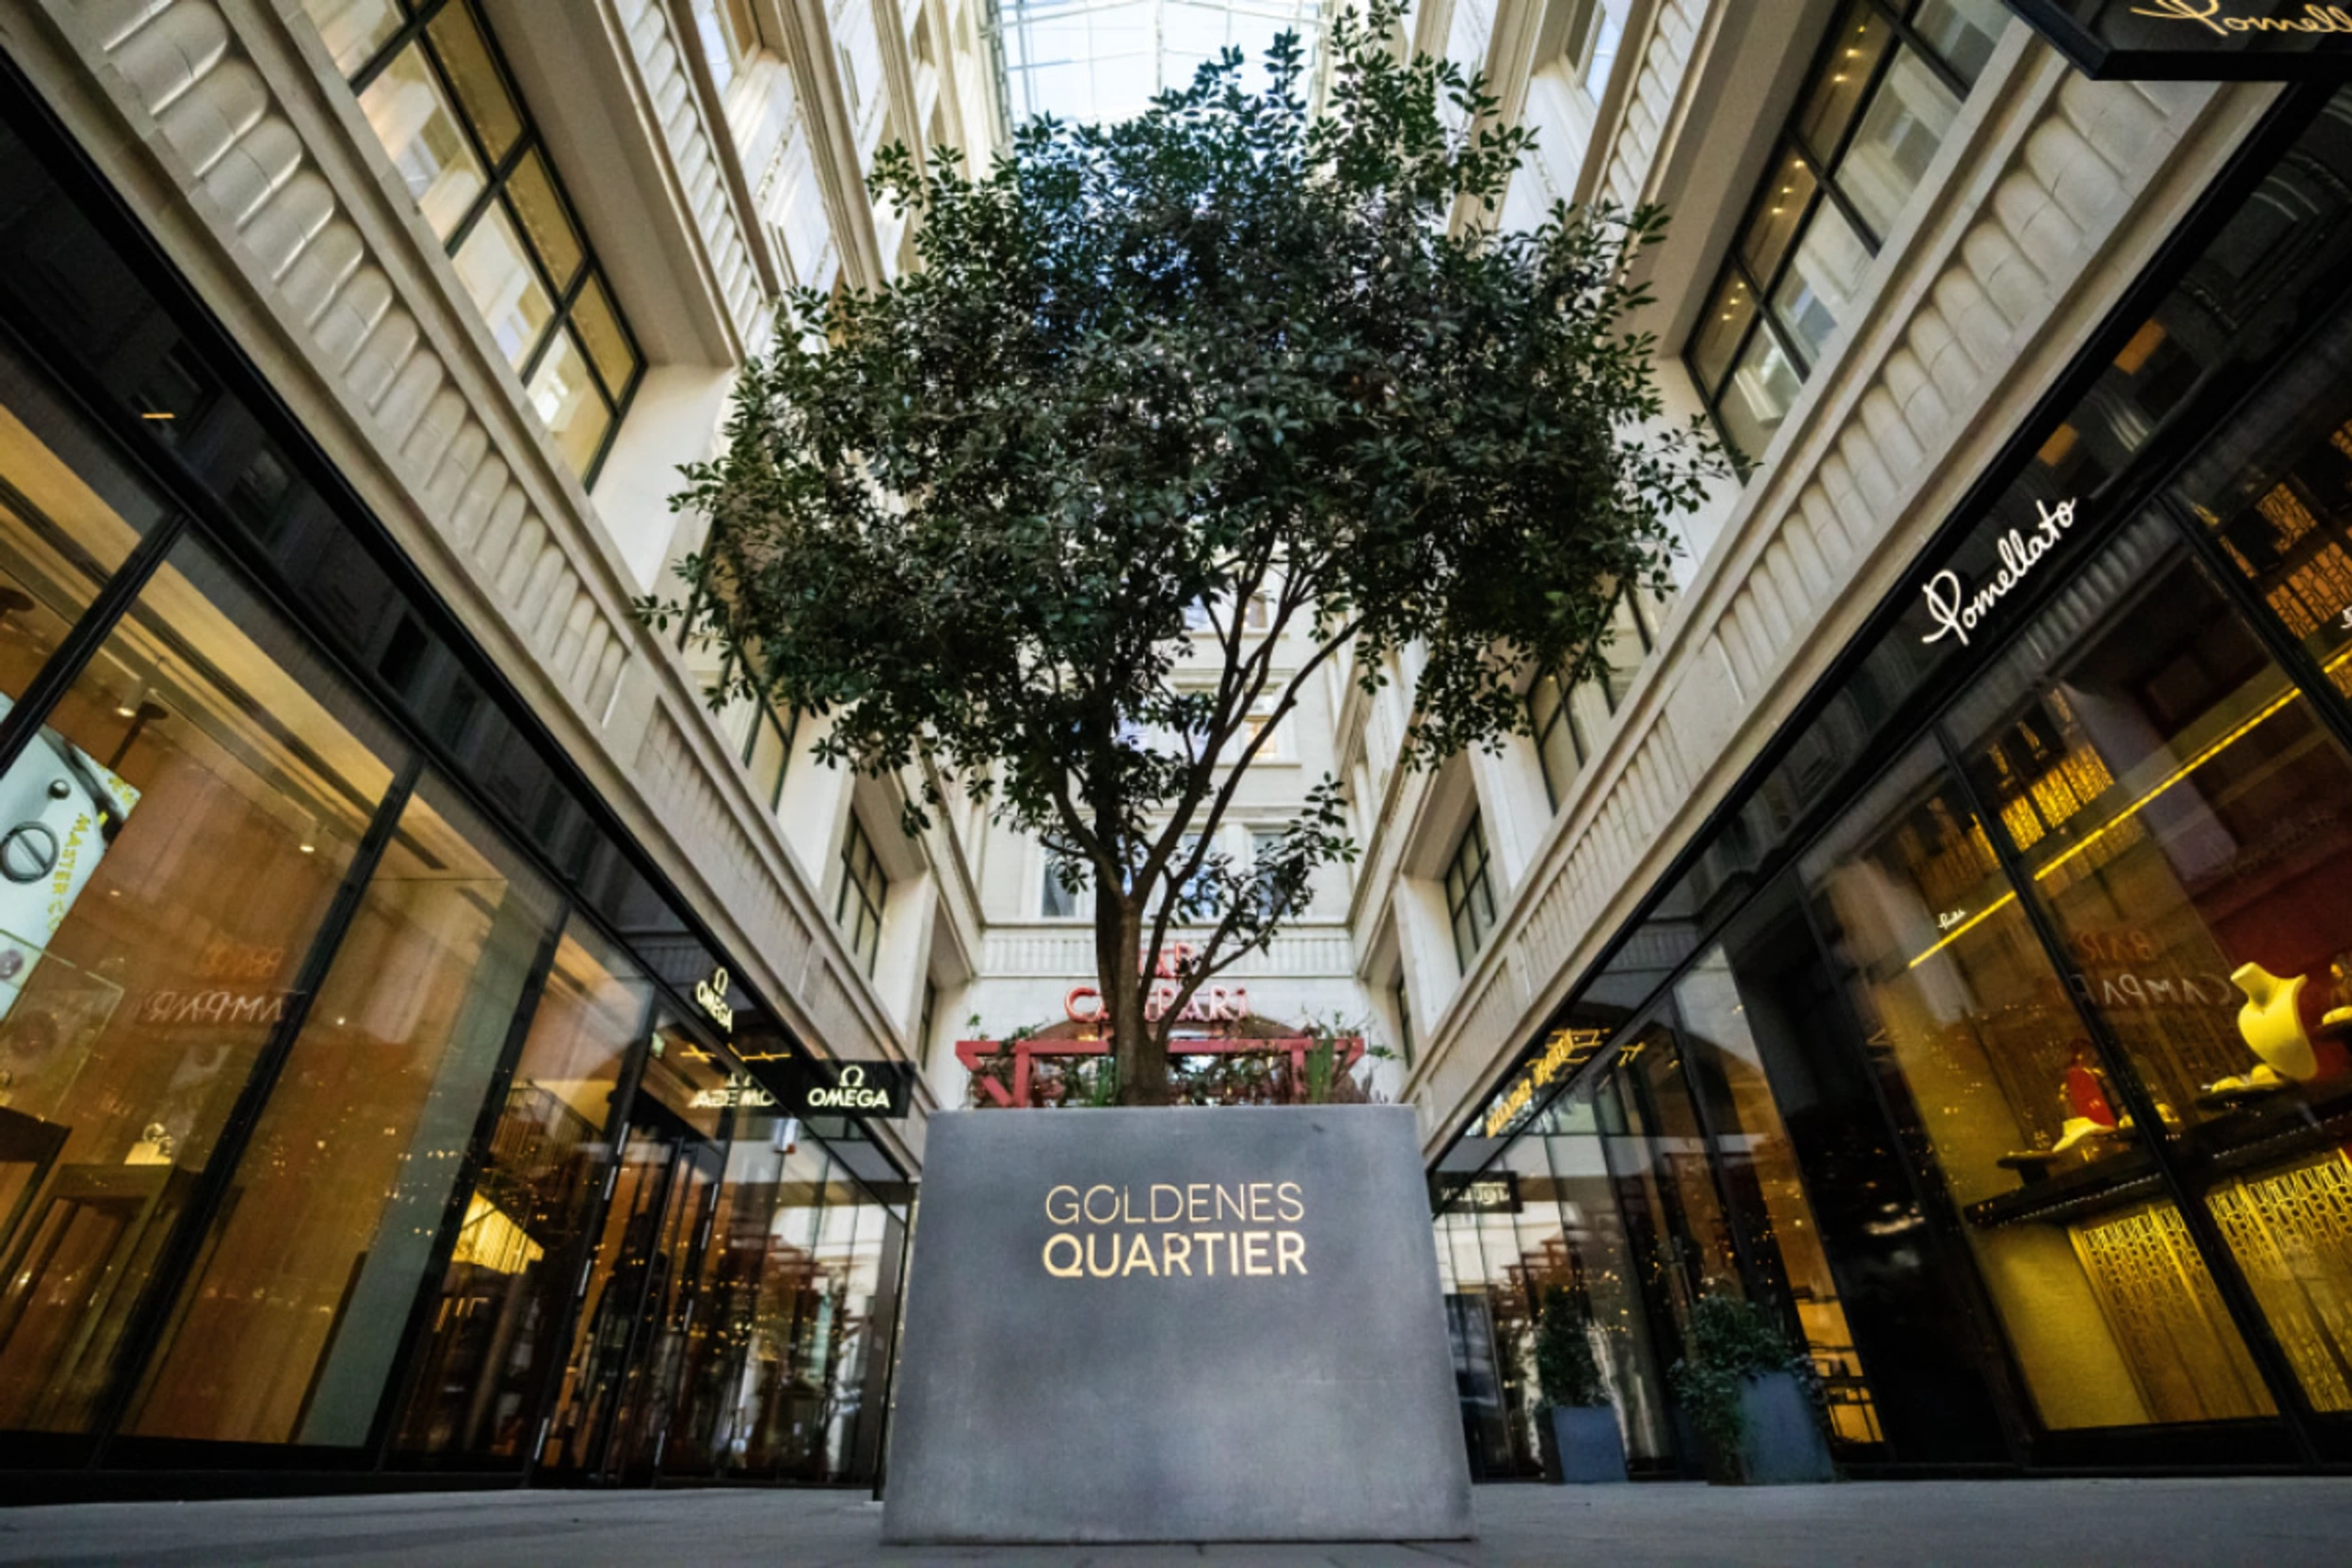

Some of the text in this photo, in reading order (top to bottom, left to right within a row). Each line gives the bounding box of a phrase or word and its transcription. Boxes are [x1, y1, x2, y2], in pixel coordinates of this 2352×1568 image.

[1922, 497, 2076, 646] Pomellato
[695, 979, 733, 1033] OMEGA
[808, 1088, 891, 1109] OMEGA
[1046, 1181, 1306, 1224] GOLDENES
[1042, 1231, 1309, 1278] QUARTIER
